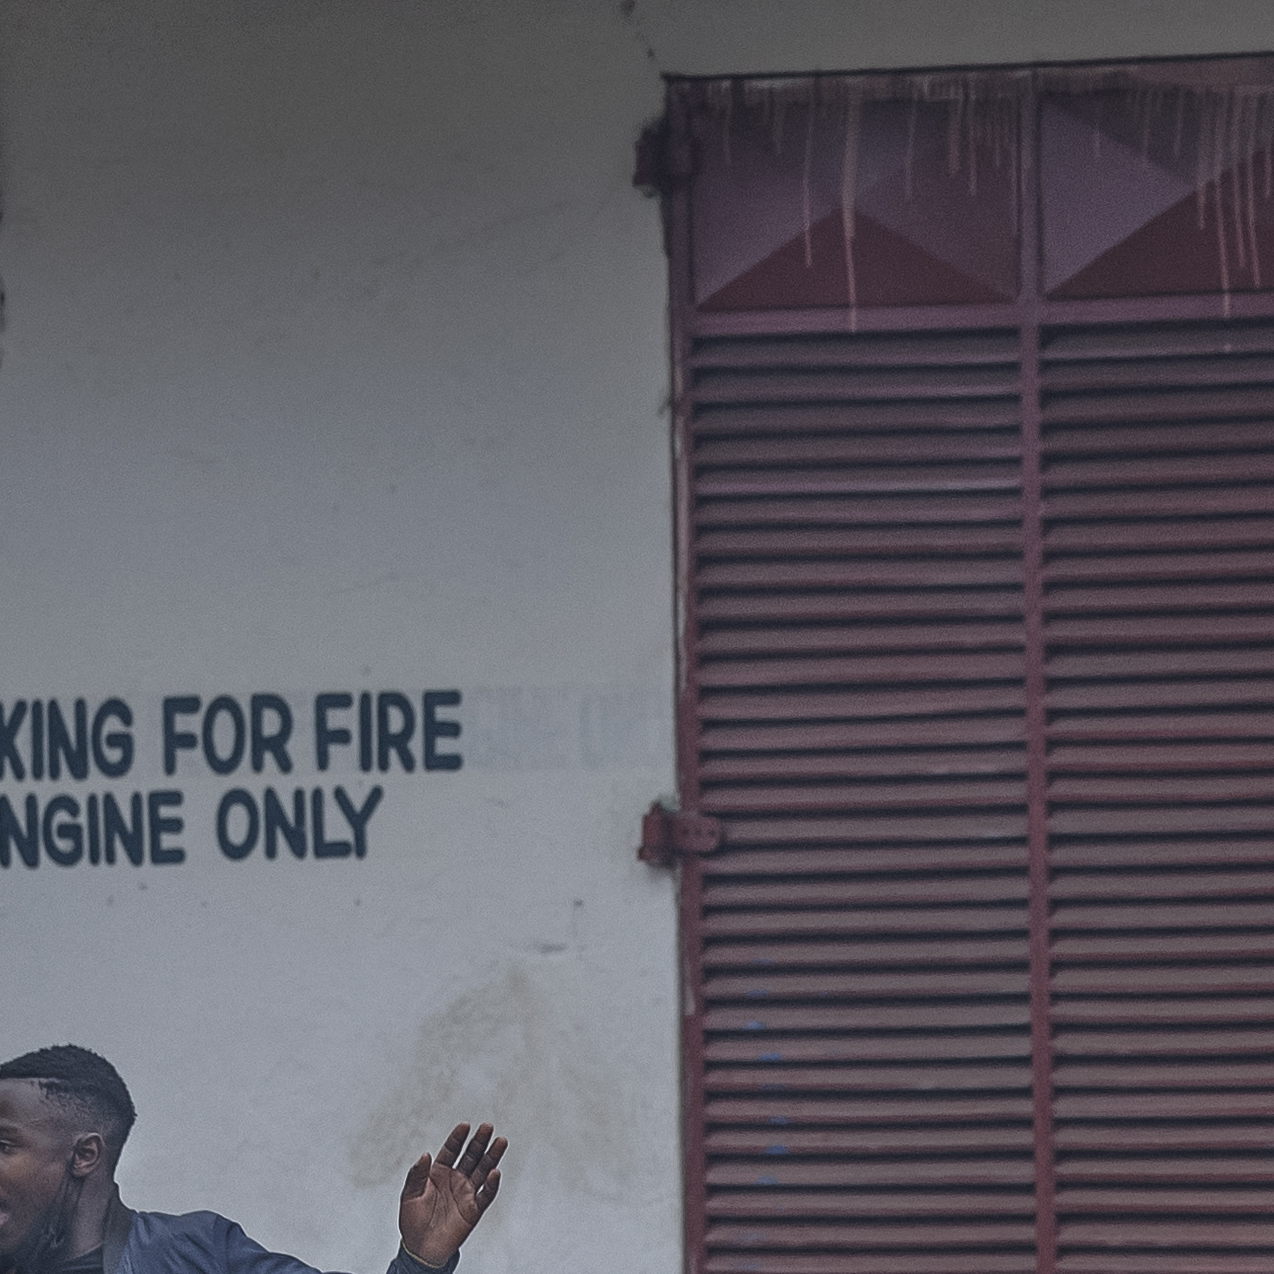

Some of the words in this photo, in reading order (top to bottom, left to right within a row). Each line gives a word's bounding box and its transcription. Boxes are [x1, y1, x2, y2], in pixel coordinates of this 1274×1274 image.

[161, 692, 295, 776] FOR
[313, 689, 463, 773] FIRE
[216, 785, 384, 861] ONLY
